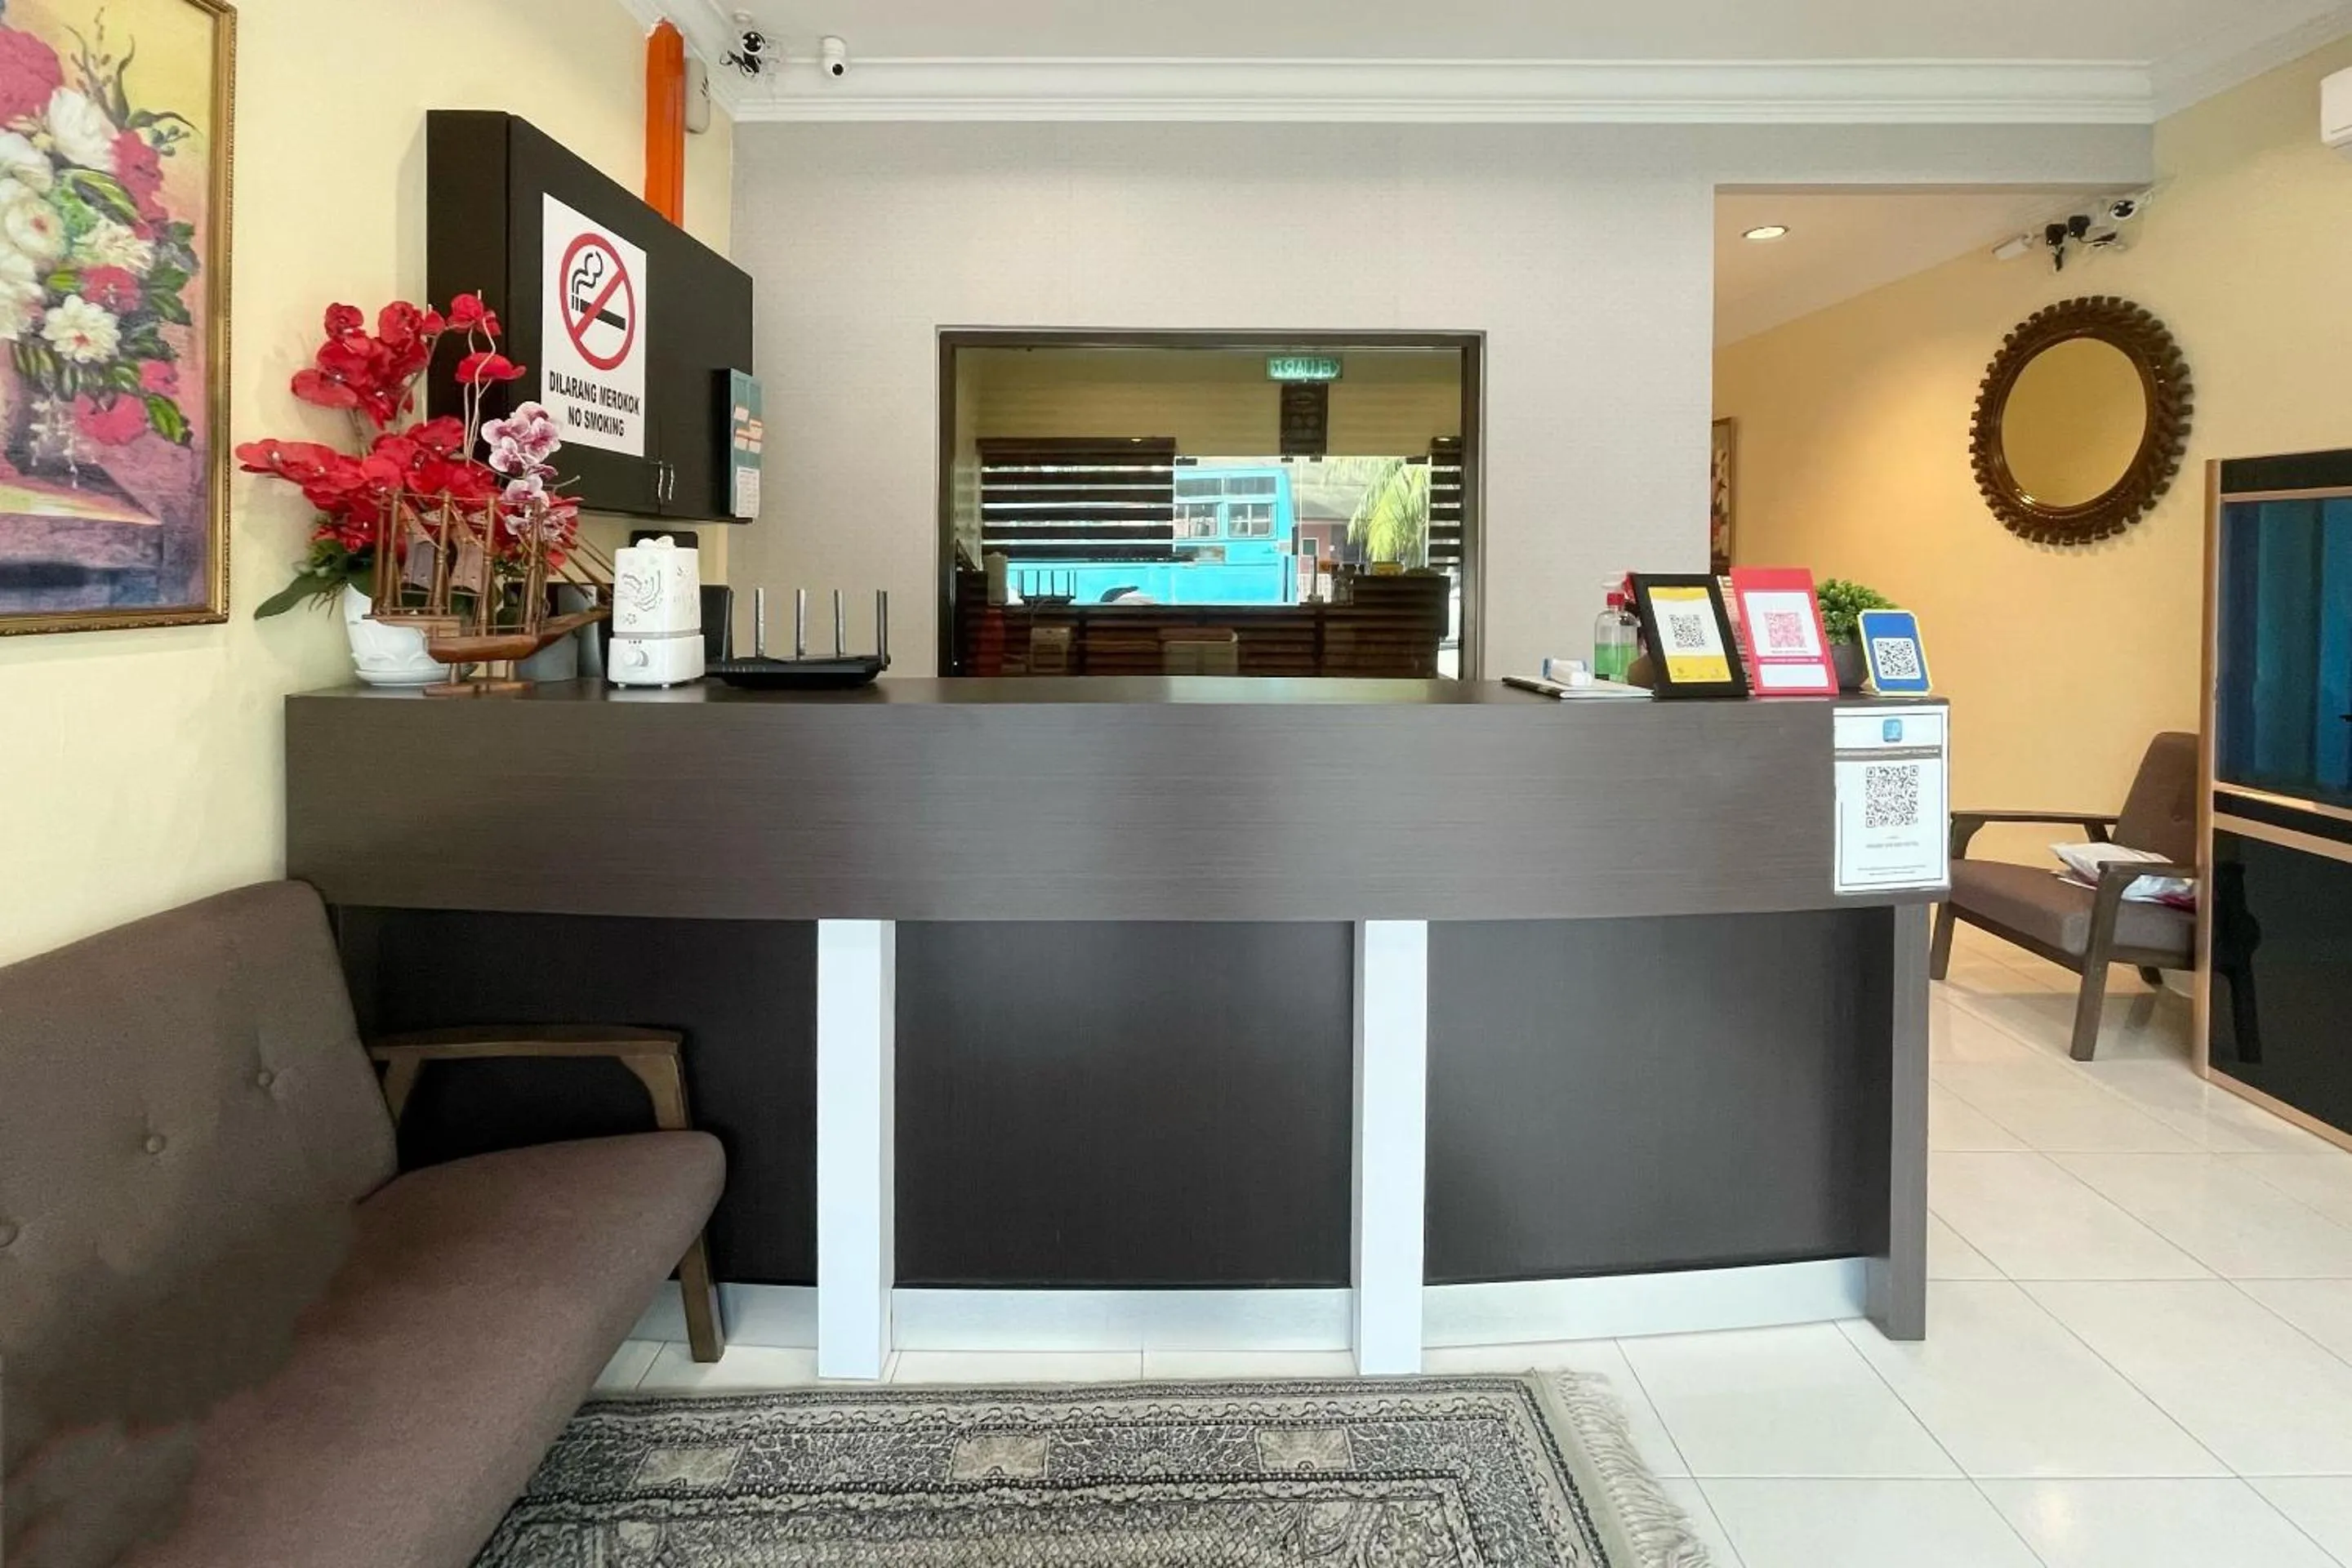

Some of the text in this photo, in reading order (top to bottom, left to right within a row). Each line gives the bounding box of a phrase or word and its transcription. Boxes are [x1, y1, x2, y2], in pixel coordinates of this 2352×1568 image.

[550, 370, 640, 416] DILARANG MEROKOK
[568, 406, 625, 437] NO SMOKING
